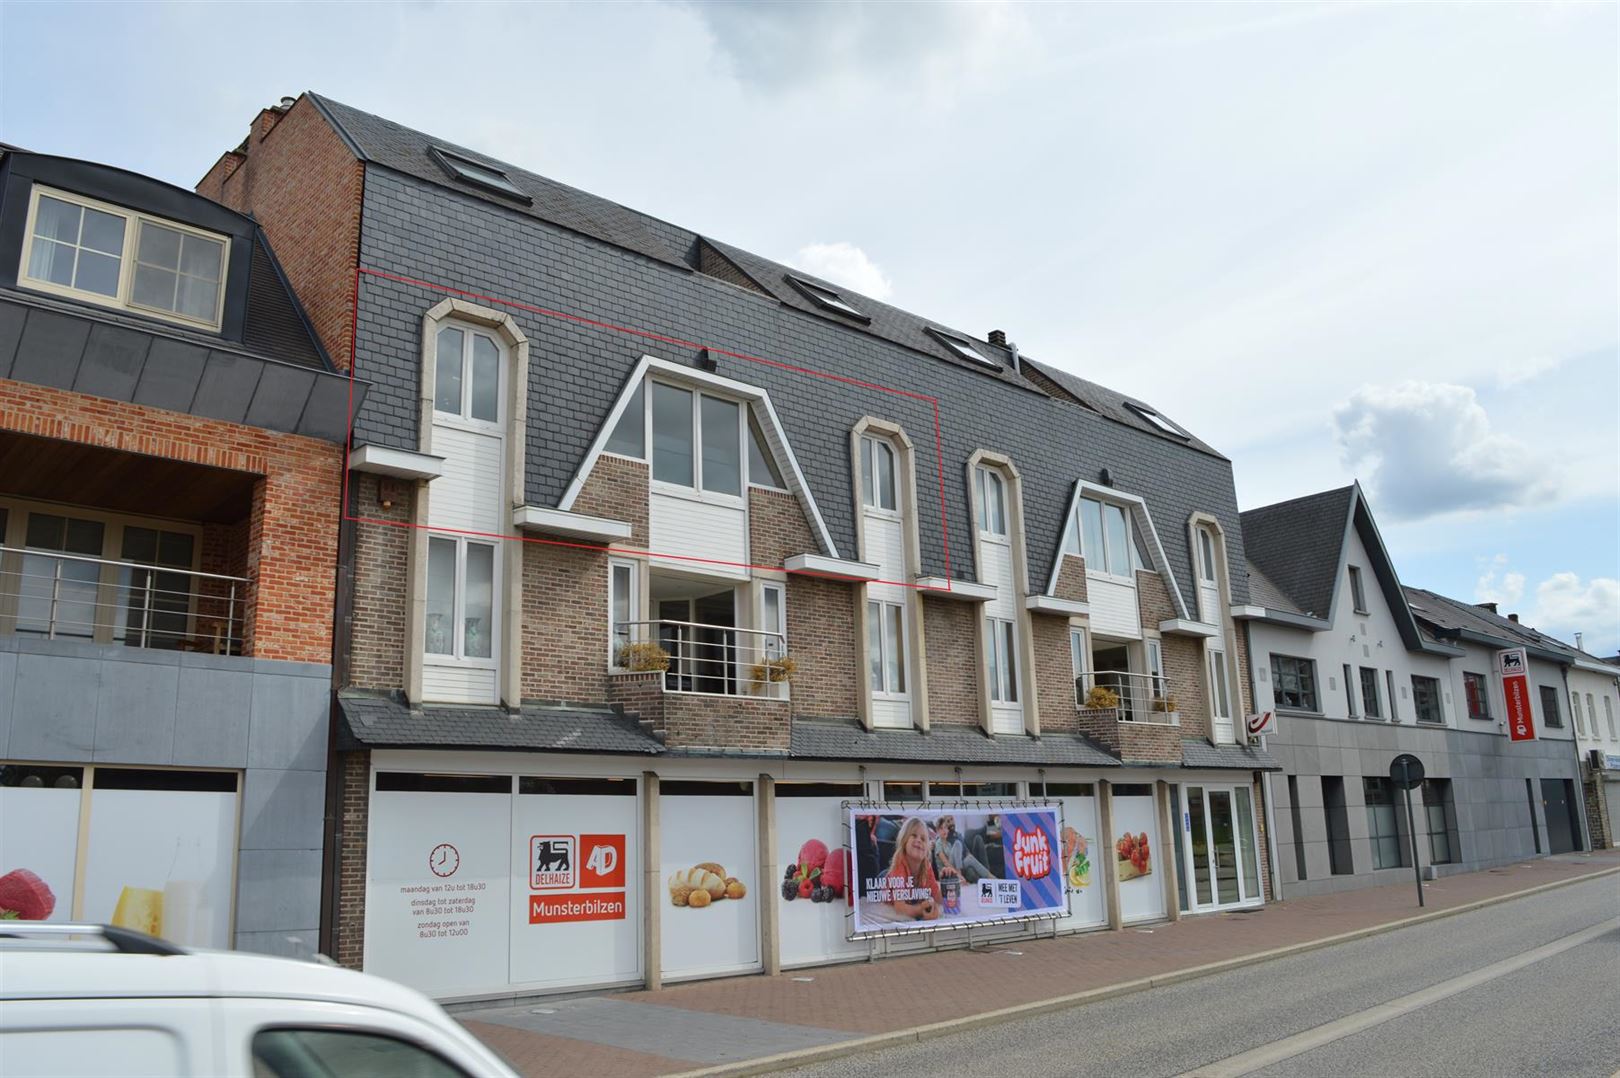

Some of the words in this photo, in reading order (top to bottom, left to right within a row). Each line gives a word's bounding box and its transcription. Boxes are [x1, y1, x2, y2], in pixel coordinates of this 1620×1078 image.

[1013, 826, 1048, 854] Junk
[586, 845, 617, 876] AD
[1014, 851, 1049, 877] Fruit
[535, 873, 570, 885] DELHAIZE
[866, 877, 886, 890] KLAAR
[888, 876, 905, 889] VOOR
[906, 876, 914, 888] JE
[400, 885, 430, 894] maandag
[444, 884, 455, 892] 12u
[467, 883, 486, 891] 18u30
[411, 899, 436, 907] dinsdag
[448, 897, 476, 906] zaterdag
[866, 890, 892, 903] NIEUWE
[893, 888, 932, 901] VERSLAVING?
[426, 907, 443, 915] 8u30
[533, 899, 622, 917] Munsterbilzen
[417, 921, 441, 930] zondag
[419, 930, 437, 938] 8u30
[449, 928, 468, 936] 12u00
